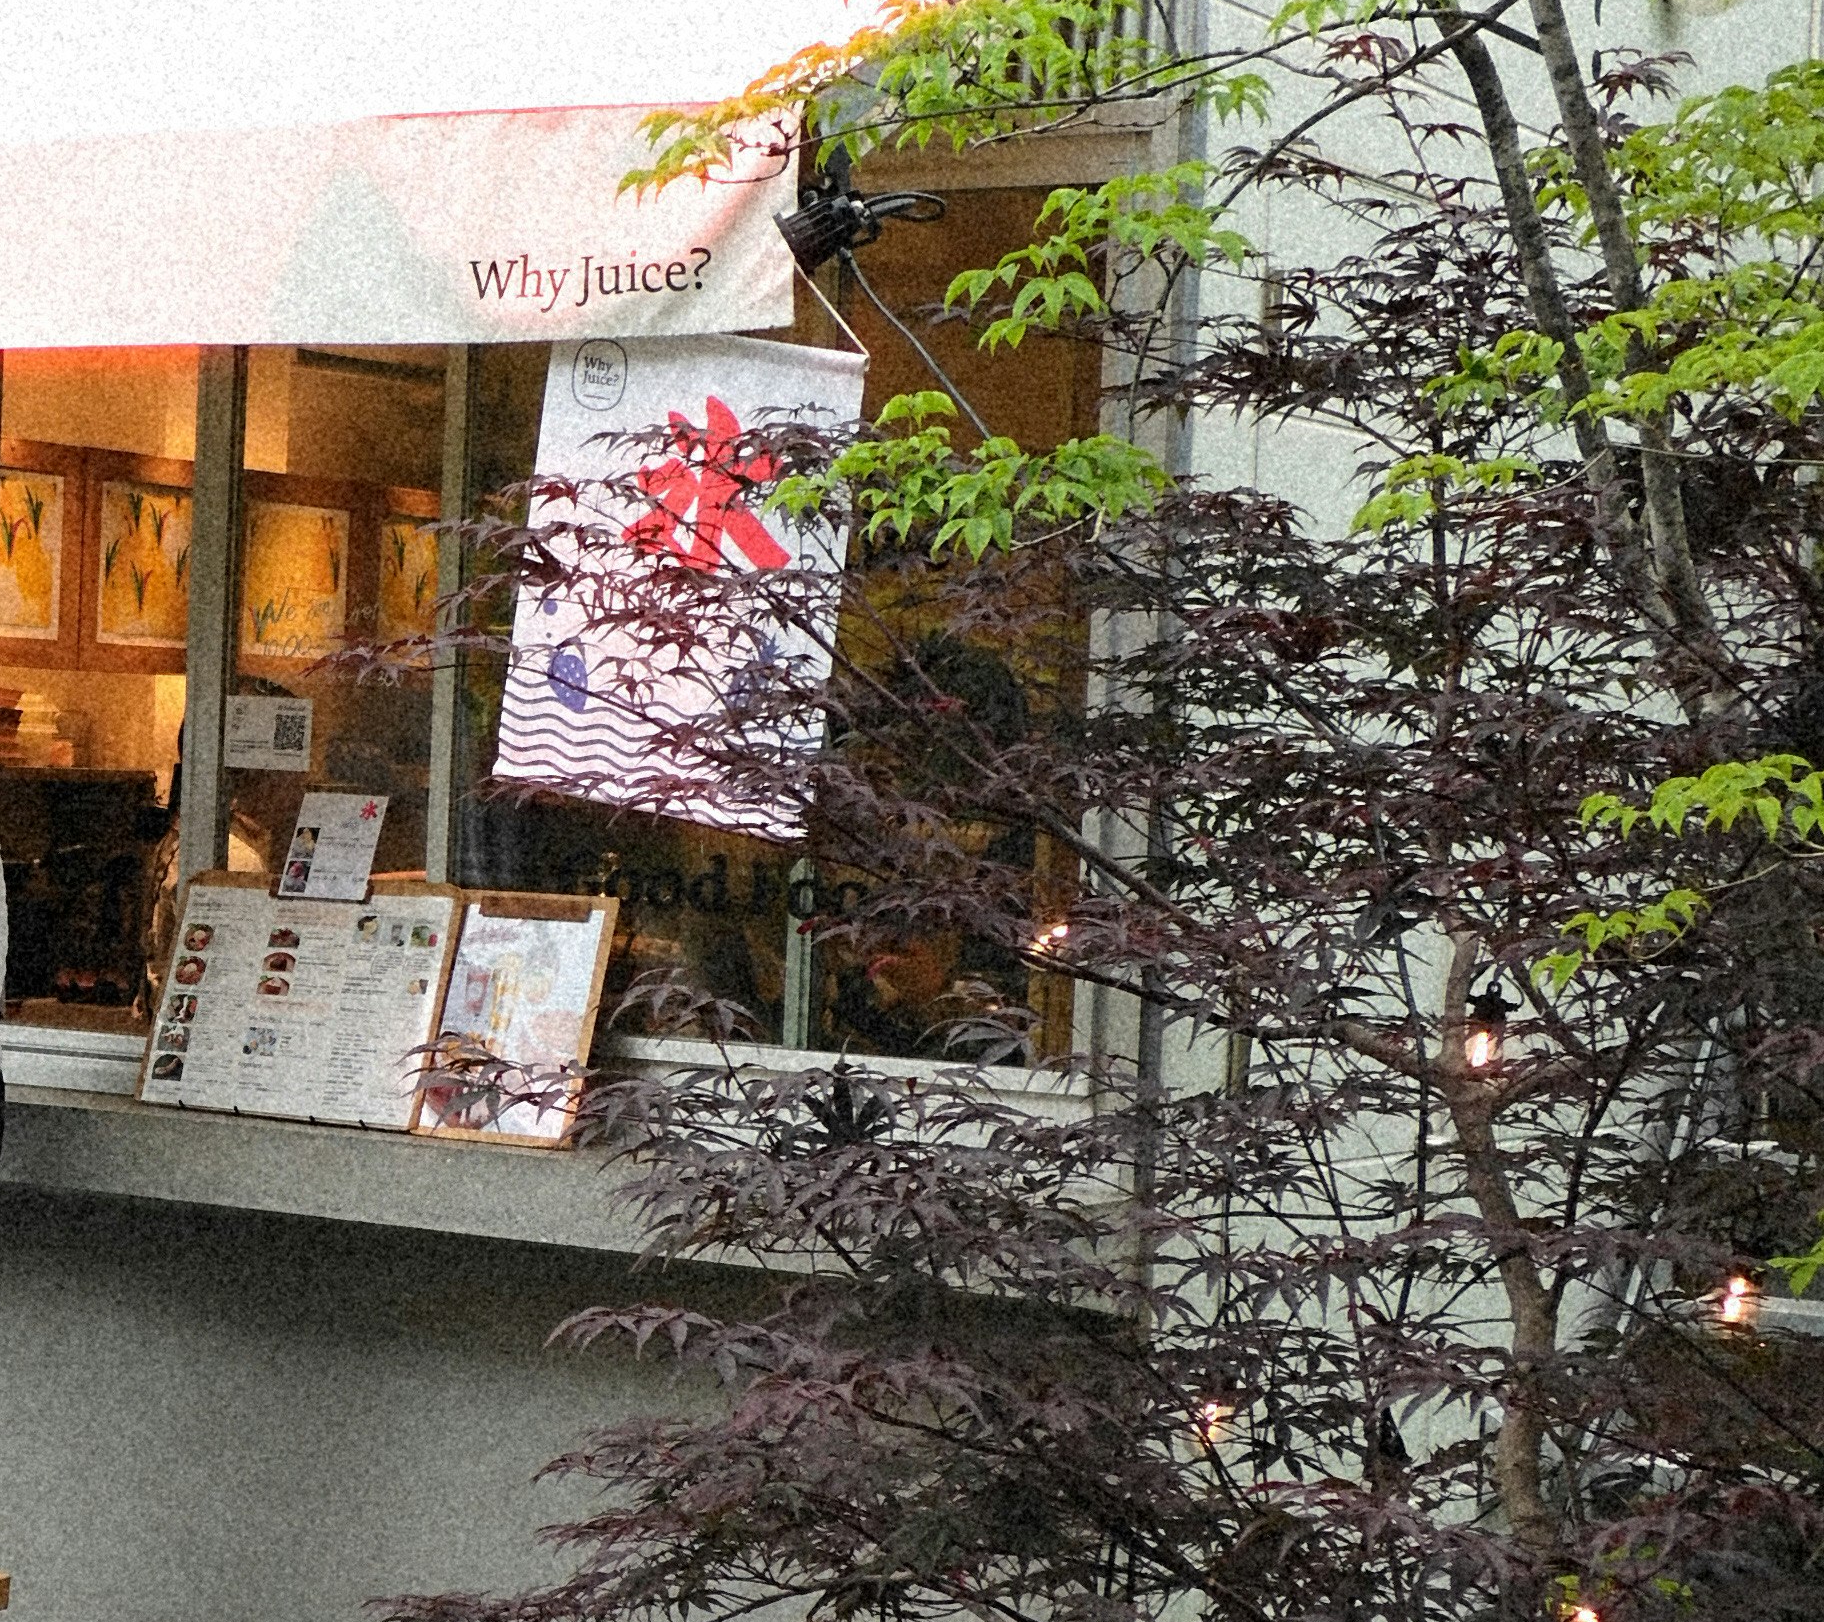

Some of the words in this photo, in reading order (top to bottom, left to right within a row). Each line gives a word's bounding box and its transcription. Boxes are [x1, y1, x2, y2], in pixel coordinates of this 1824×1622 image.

[469, 254, 571, 313] Why
[575, 247, 713, 307] Juice?
[581, 369, 620, 388] Juice?
[583, 354, 616, 377] Why
[621, 394, 792, 575] 氷
